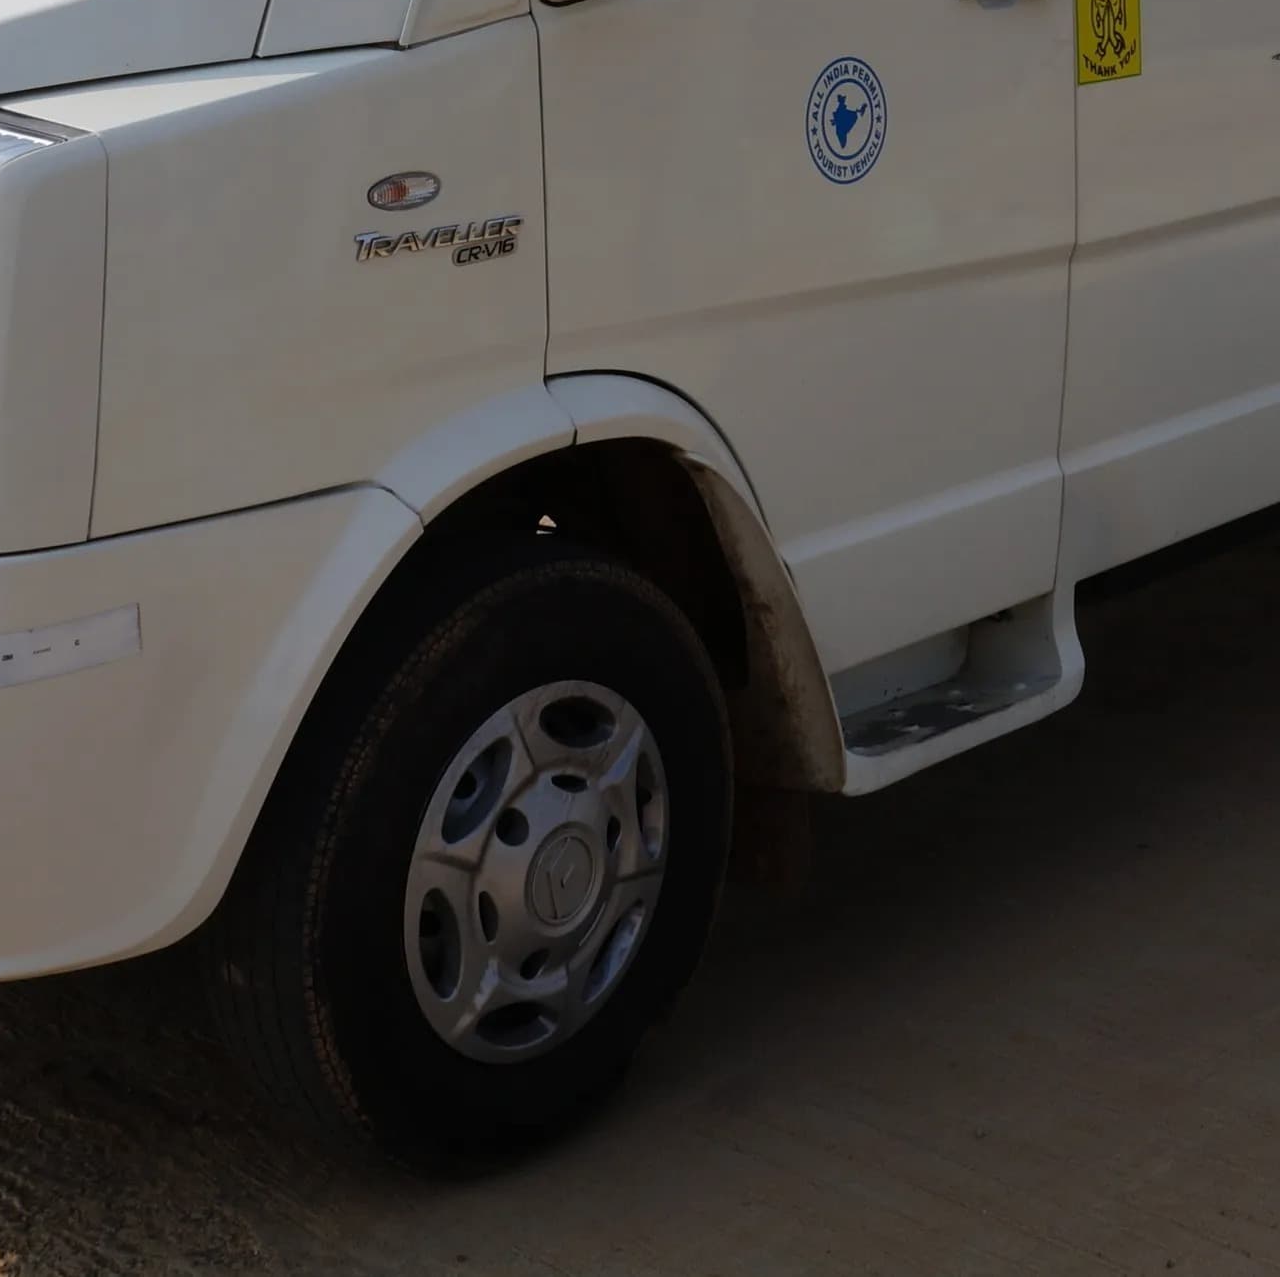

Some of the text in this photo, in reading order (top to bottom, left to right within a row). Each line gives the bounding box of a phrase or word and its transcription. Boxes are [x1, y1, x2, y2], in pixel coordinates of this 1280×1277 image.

[1083, 38, 1137, 77] THANK YOU
[812, 64, 881, 122] ALL INDIA PERMIT
[813, 129, 881, 178] TOURIST VEHICLE
[354, 215, 524, 263] TRAVELLER
